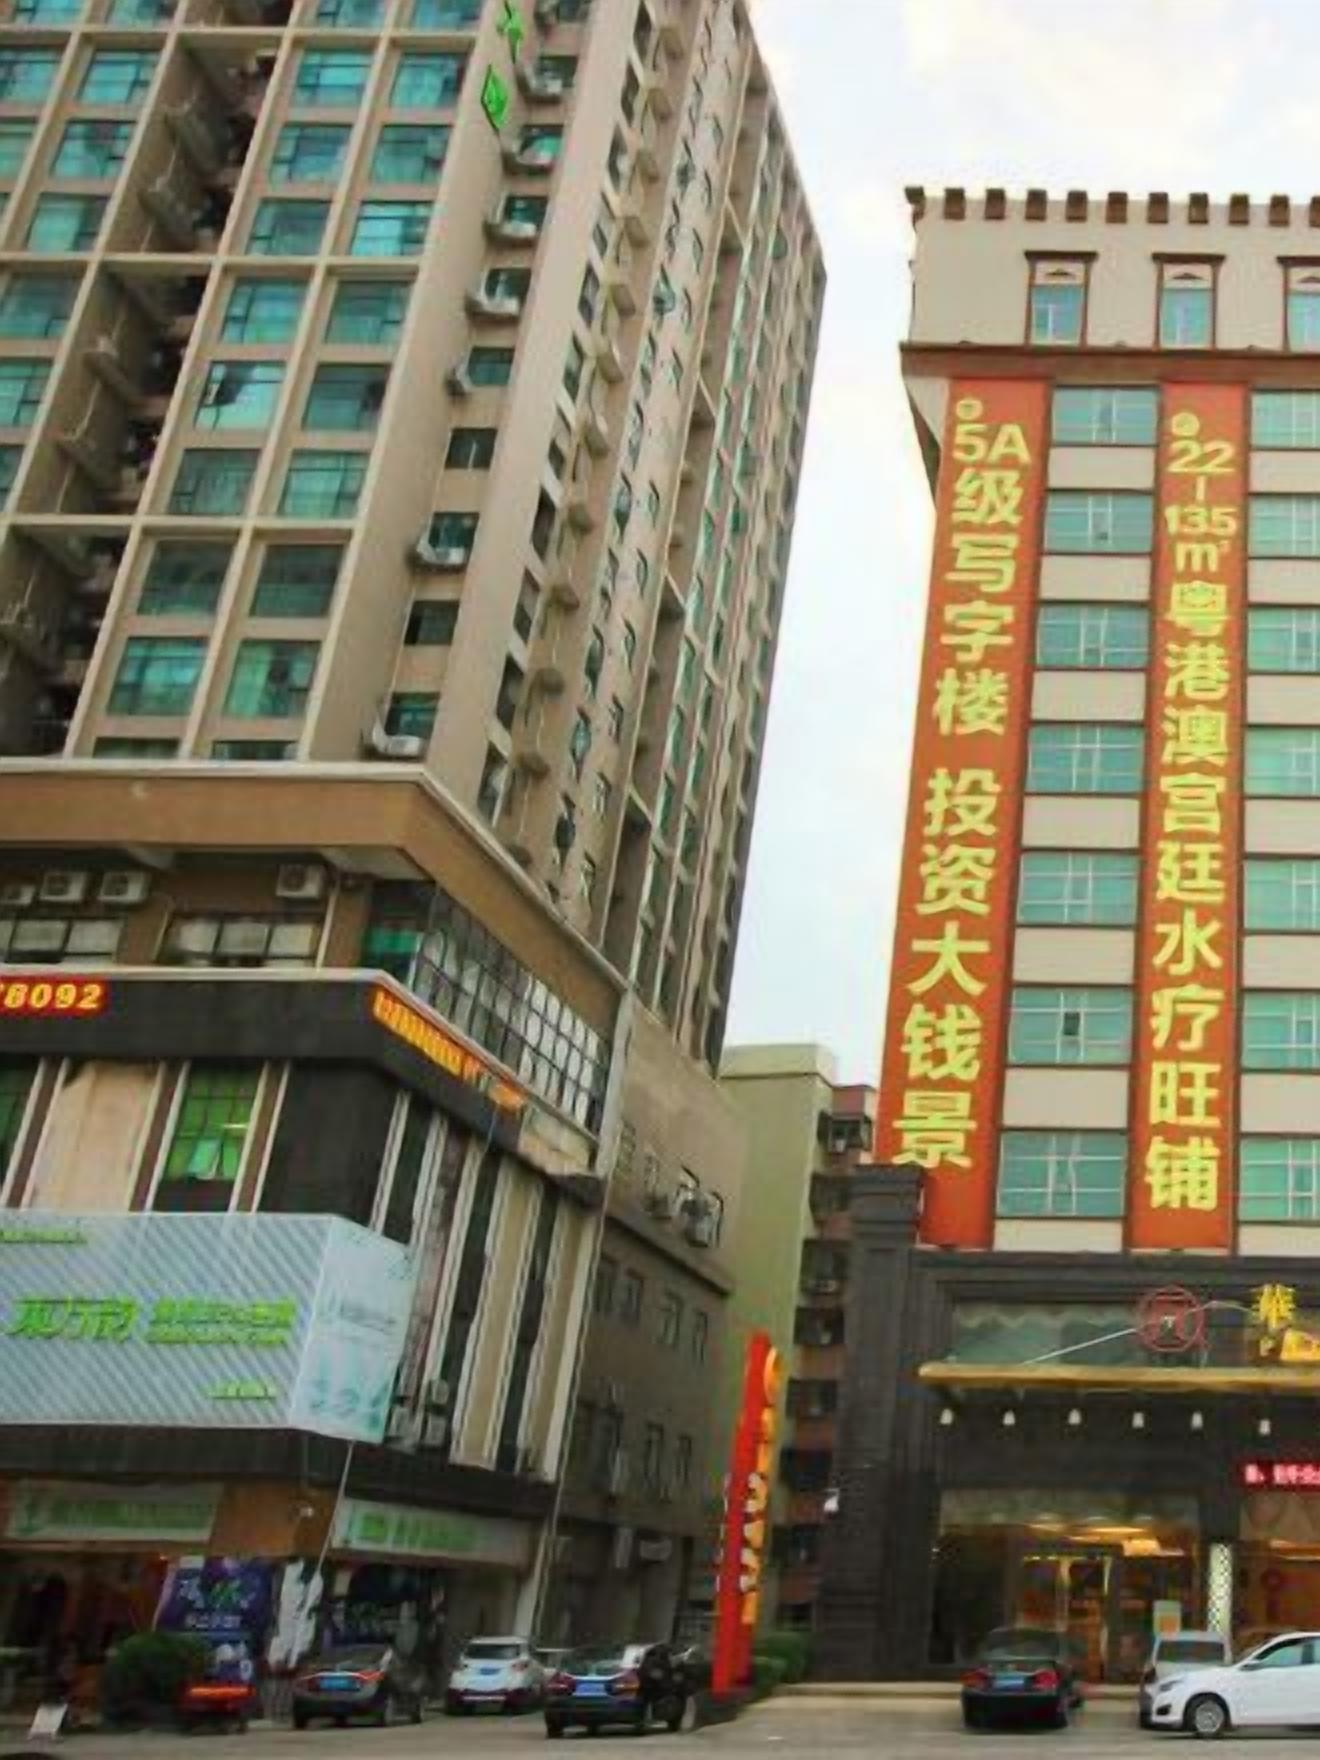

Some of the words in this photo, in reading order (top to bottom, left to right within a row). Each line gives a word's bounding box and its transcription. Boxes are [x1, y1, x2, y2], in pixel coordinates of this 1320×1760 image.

[892, 768, 1001, 1169] 投资大钱景
